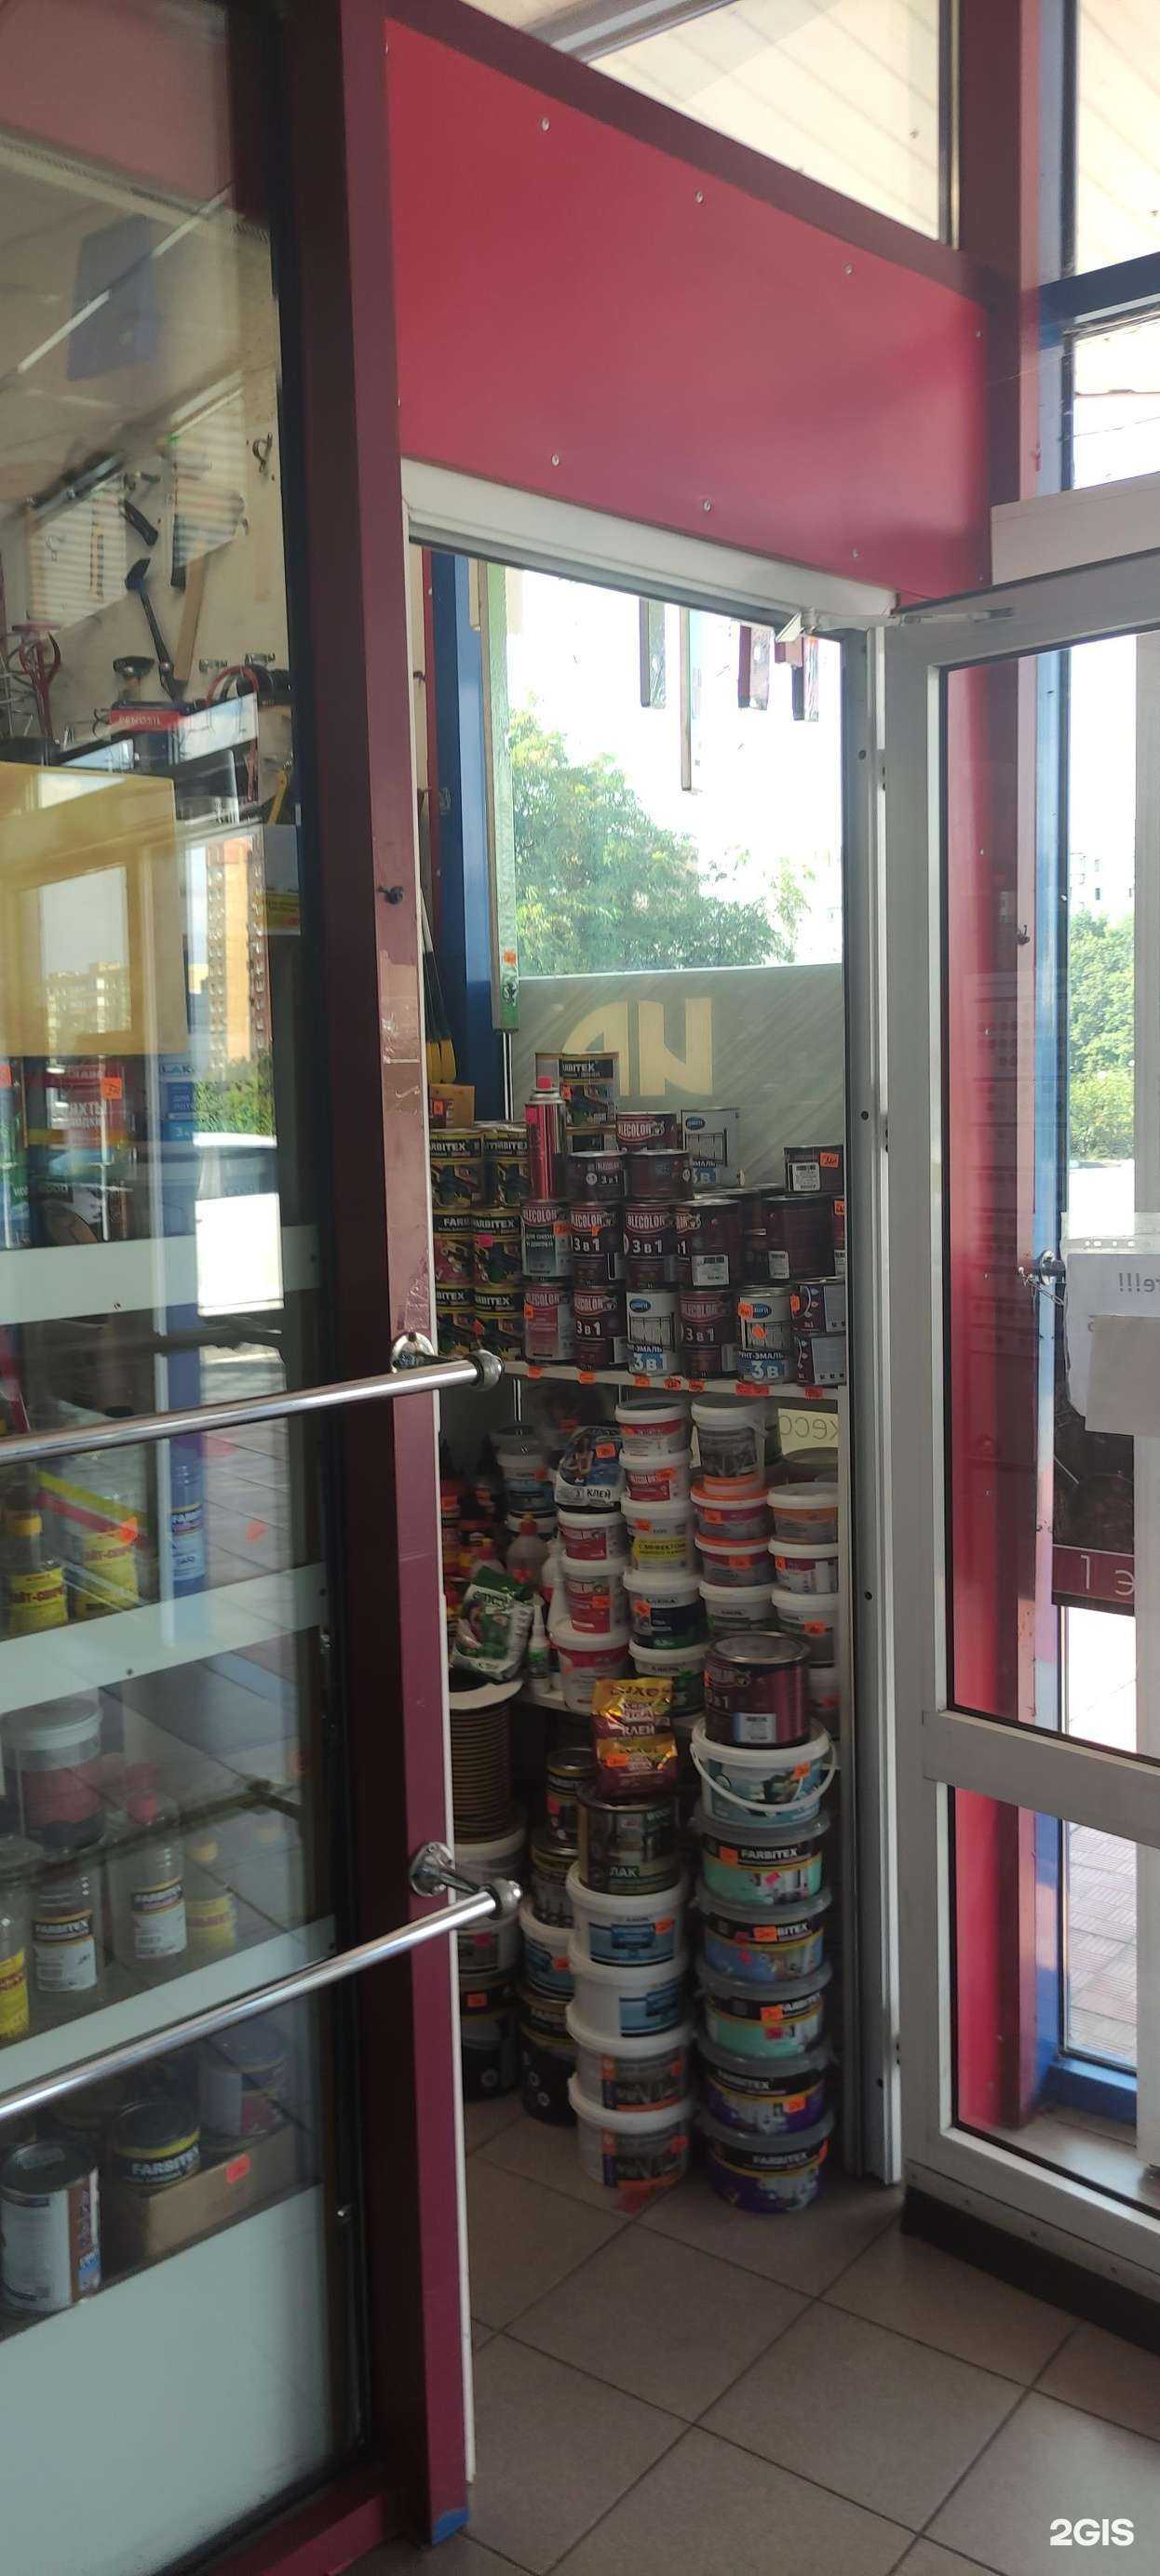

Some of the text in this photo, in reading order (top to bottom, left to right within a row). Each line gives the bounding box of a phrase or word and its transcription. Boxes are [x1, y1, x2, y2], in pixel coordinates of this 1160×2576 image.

[573, 1237, 581, 1252] 3
[592, 1238, 600, 1252] 1
[632, 1239, 641, 1254] 3
[654, 1240, 663, 1254] 1
[575, 1320, 583, 1335] 3
[593, 1321, 601, 1336] 1
[685, 1327, 694, 1341] 3
[708, 1327, 715, 1342] 1
[633, 1353, 642, 1371] 3
[751, 1360, 764, 1379] 3
[609, 1867, 638, 1878] ЛАК
